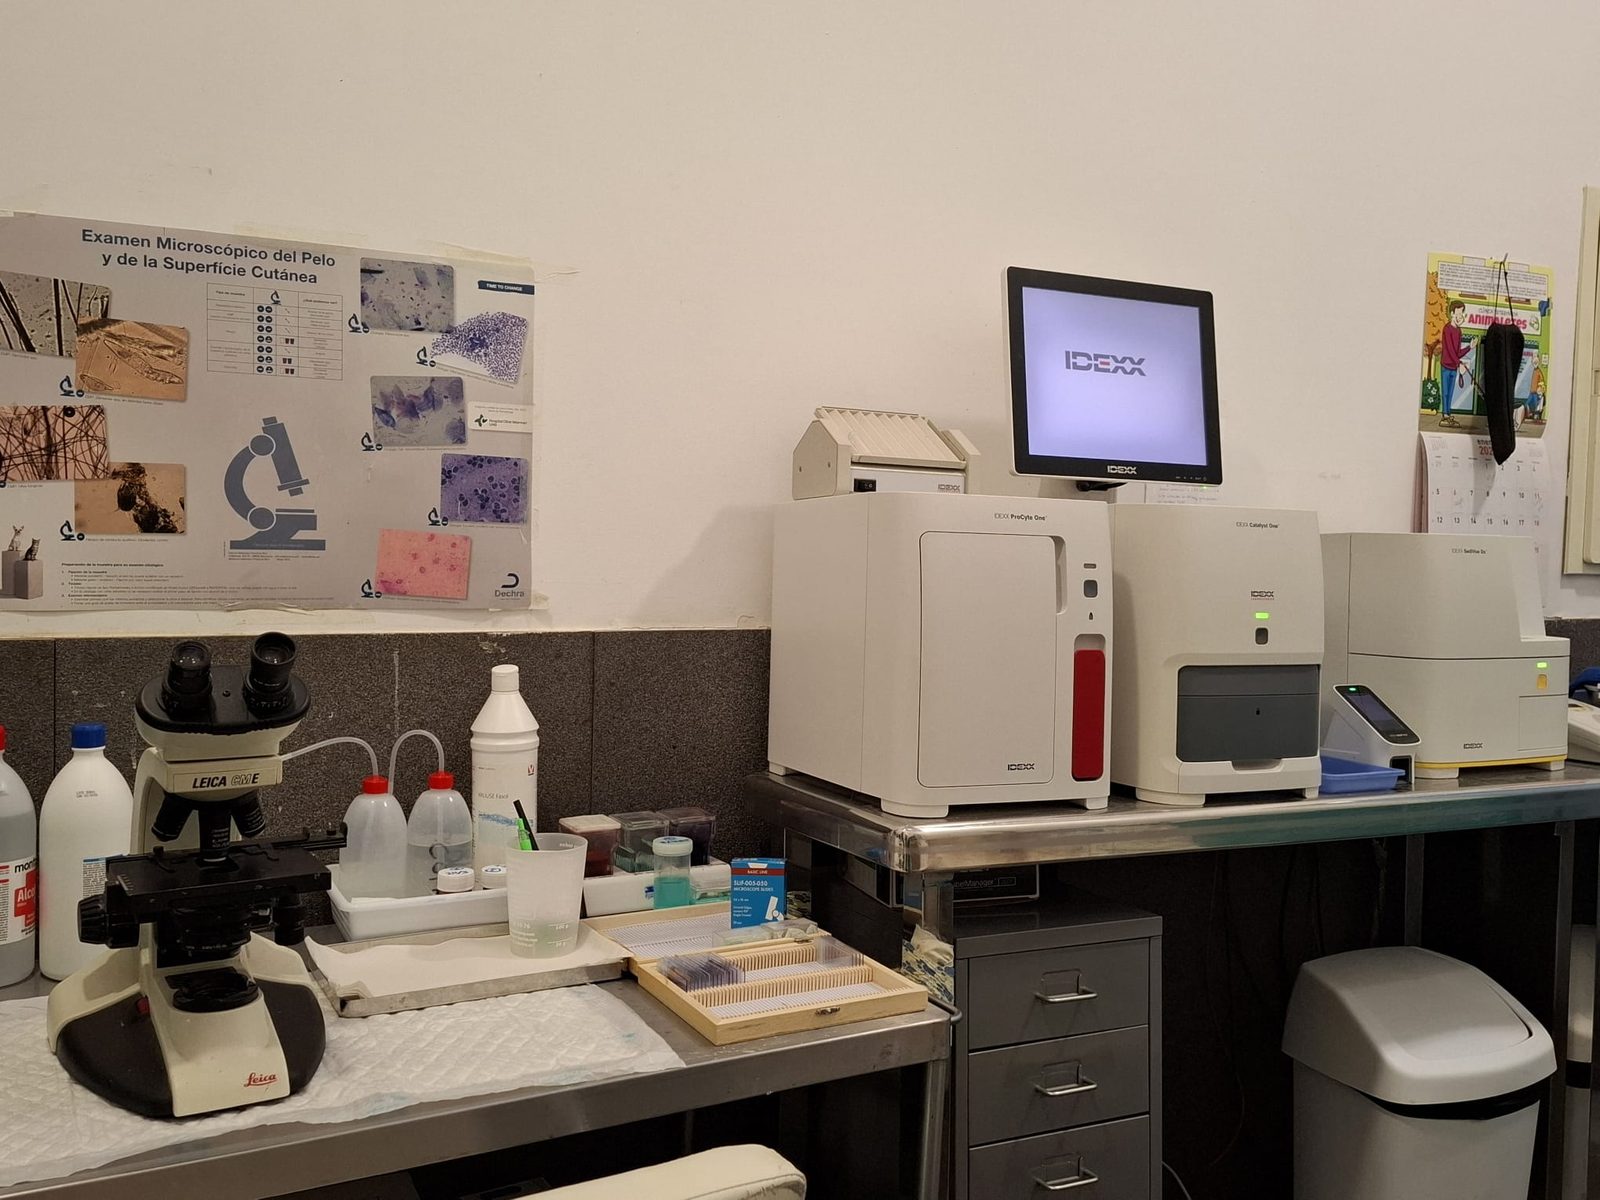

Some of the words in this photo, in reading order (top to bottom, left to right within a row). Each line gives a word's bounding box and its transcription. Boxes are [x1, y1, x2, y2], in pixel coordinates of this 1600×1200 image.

[81, 228, 151, 248] Examen
[156, 236, 269, 261] Microscópico
[273, 249, 297, 263] del
[301, 251, 336, 267] Pelo
[102, 252, 112, 266] y
[117, 252, 138, 266] de
[143, 254, 158, 268] la
[163, 256, 247, 277] Superfície
[251, 265, 318, 284] Cutánea
[1065, 350, 1147, 377] IDEXX
[1479, 446, 1493, 456] 202
[1107, 465, 1137, 475] IDEXX
[1010, 513, 1033, 521] ProCyte
[1437, 516, 1443, 524] 12
[495, 590, 525, 598] Dechra
[1250, 590, 1274, 598] IDEXX
[1007, 763, 1035, 771] IDEXX
[192, 776, 227, 789] LEICA
[231, 773, 260, 786] CME
[243, 1072, 278, 1087] Leica
